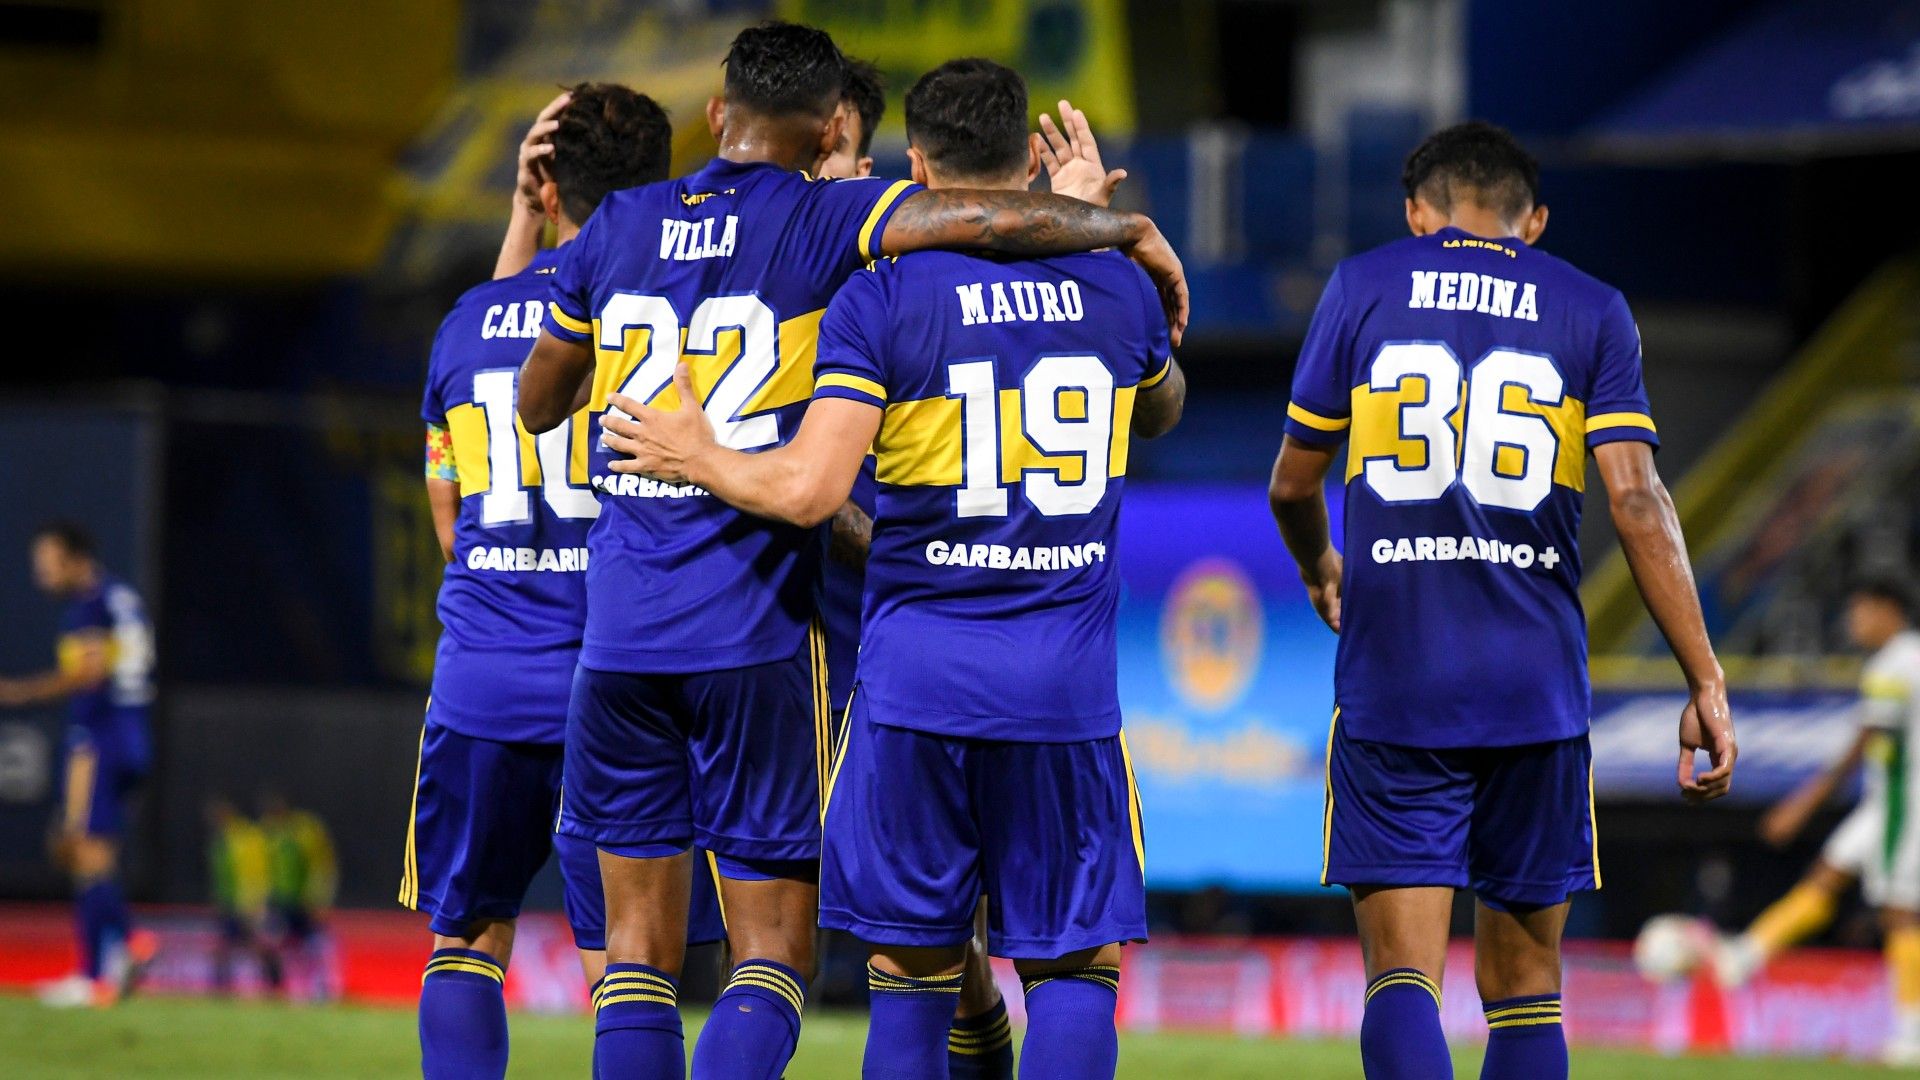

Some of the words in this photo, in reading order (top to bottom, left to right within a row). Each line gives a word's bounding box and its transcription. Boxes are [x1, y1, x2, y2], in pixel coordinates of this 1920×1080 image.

[659, 215, 738, 261] VILLA
[481, 300, 556, 340] CAR
[955, 280, 1084, 326] MAURO
[1409, 270, 1539, 322] MEDINA
[600, 292, 780, 450] 22
[947, 355, 1114, 518] 19
[1364, 342, 1564, 512] 36
